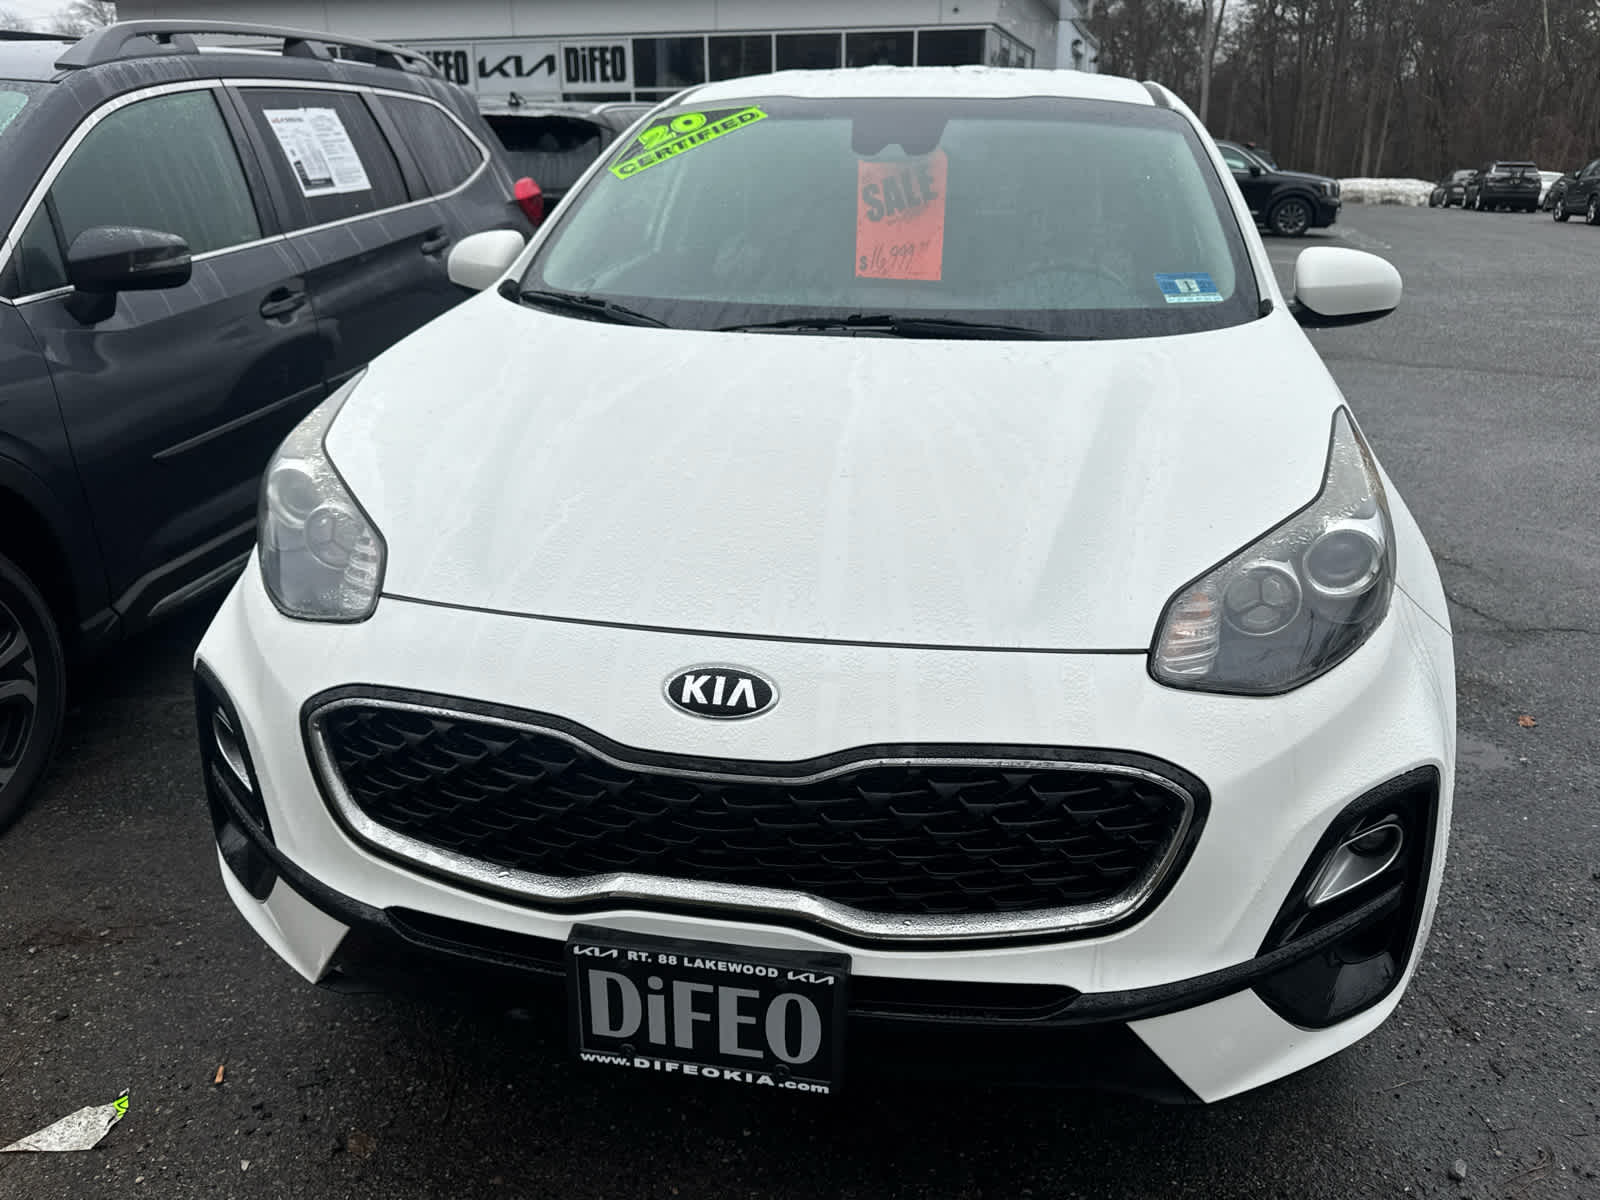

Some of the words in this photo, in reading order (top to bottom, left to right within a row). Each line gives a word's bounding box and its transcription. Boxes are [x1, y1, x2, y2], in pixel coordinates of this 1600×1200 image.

[563, 46, 627, 84] DiFEO
[618, 111, 761, 175] CERTIFIED
[638, 111, 707, 150] 20
[862, 167, 938, 222] SALE
[681, 675, 757, 708] KIA
[627, 951, 652, 963] RT.
[658, 953, 678, 966] 88
[683, 957, 779, 978] LAKEWOOD
[588, 968, 822, 1065] DiFEO
[579, 1052, 830, 1095] www.DIFEOKIA.com
